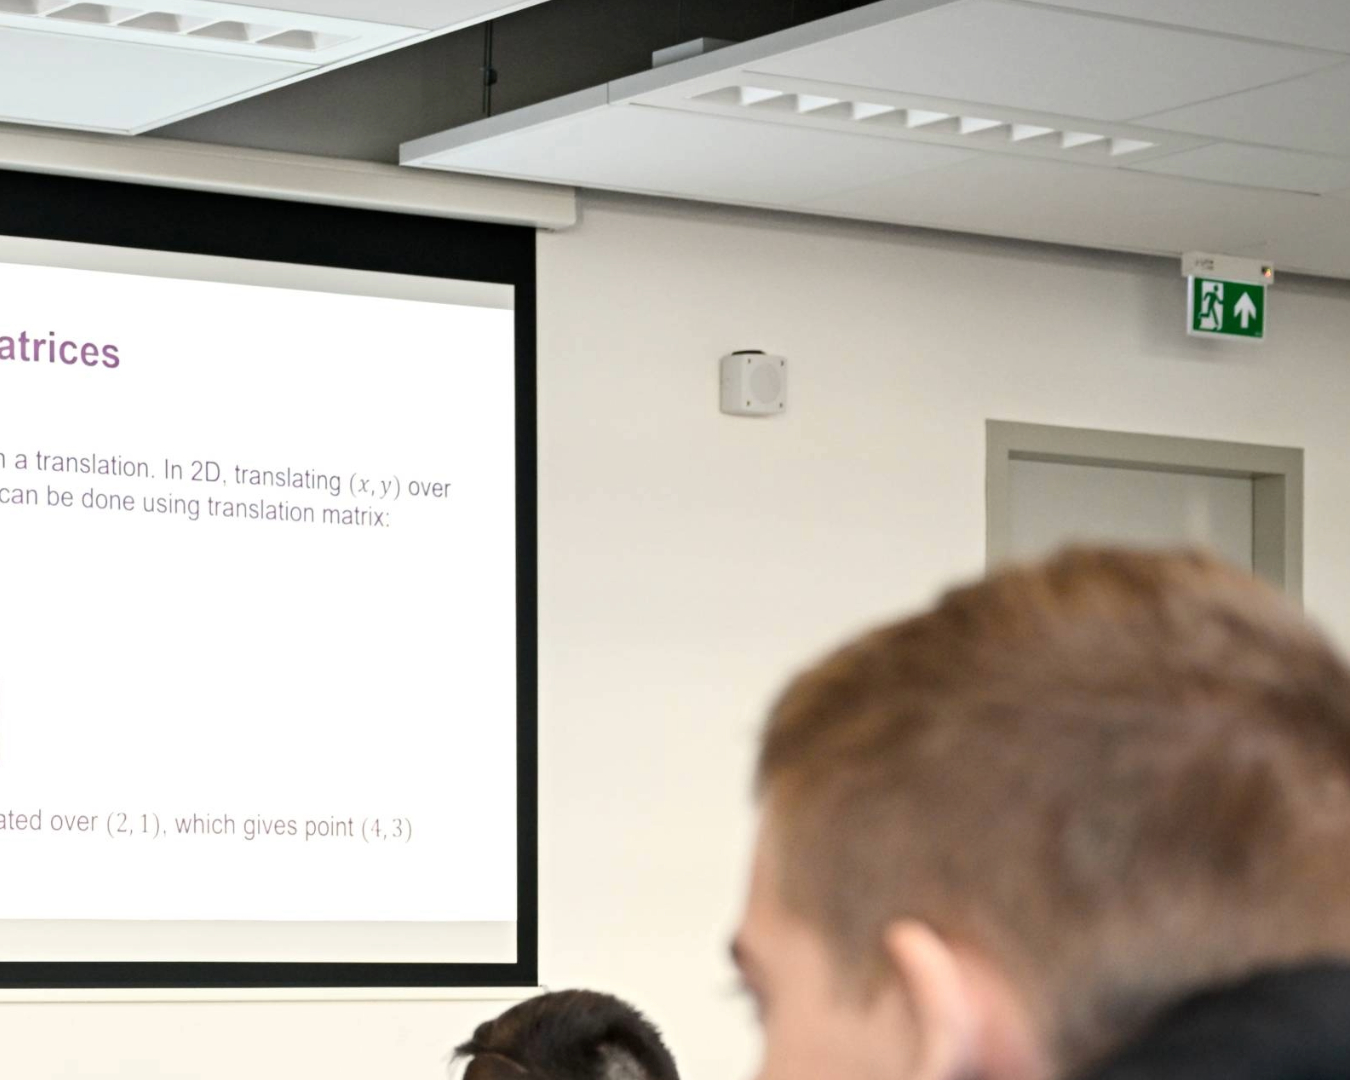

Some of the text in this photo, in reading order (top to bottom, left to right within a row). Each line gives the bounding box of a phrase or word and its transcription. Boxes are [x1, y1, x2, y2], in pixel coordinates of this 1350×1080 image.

[15, 454, 27, 469] a
[36, 451, 154, 478] translation.
[165, 459, 182, 480] In
[191, 460, 226, 486] 2D,
[235, 465, 340, 496] translating
[408, 481, 451, 498] over
[47, 485, 73, 507] be
[82, 488, 135, 511] done
[144, 493, 199, 521] using
[208, 497, 314, 522] translation
[323, 507, 389, 527] matrix:
[51, 815, 98, 831] over
[175, 813, 235, 834] which
[244, 814, 297, 840] gives
[306, 816, 353, 841] point
